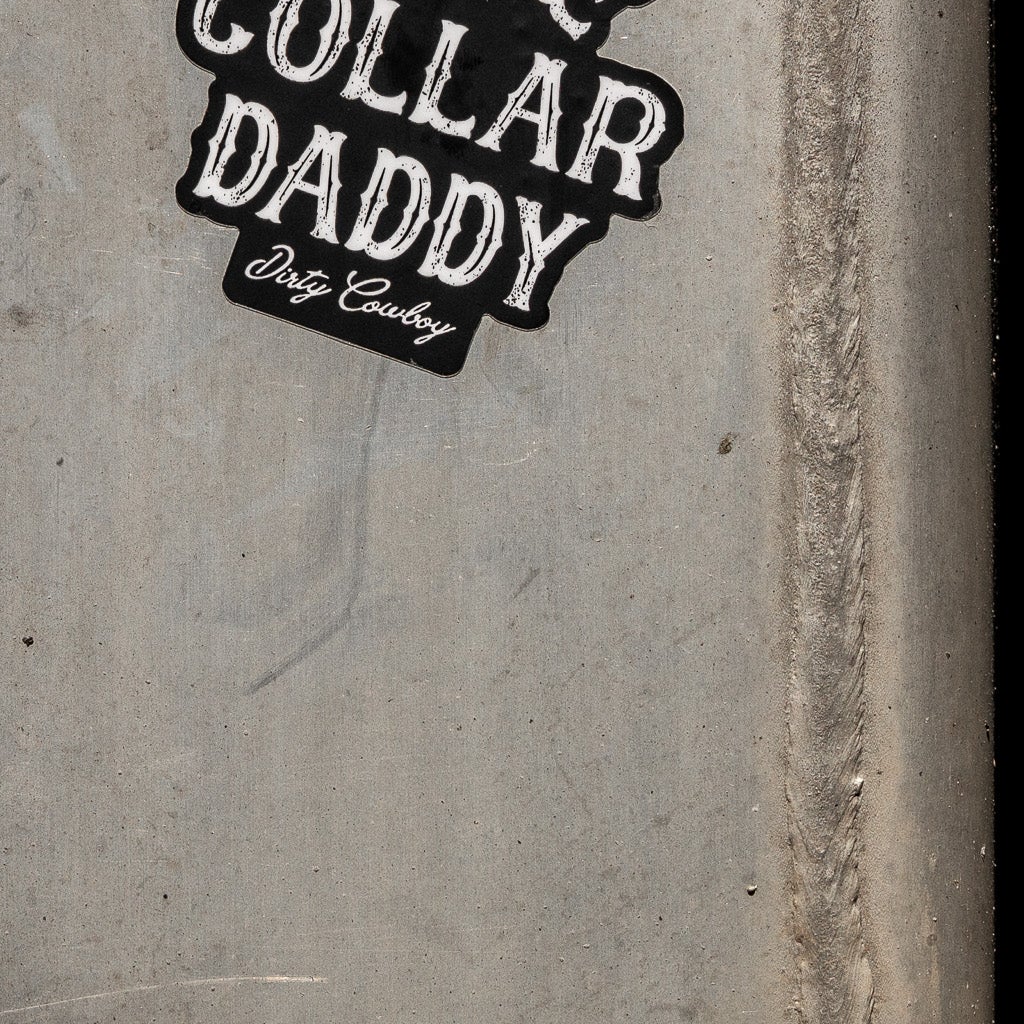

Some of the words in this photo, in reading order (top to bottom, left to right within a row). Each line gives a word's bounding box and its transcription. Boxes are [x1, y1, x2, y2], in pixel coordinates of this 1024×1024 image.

[192, 93, 590, 311] DADDY
[245, 245, 332, 303] Dirty
[339, 270, 456, 345] Cowboy
